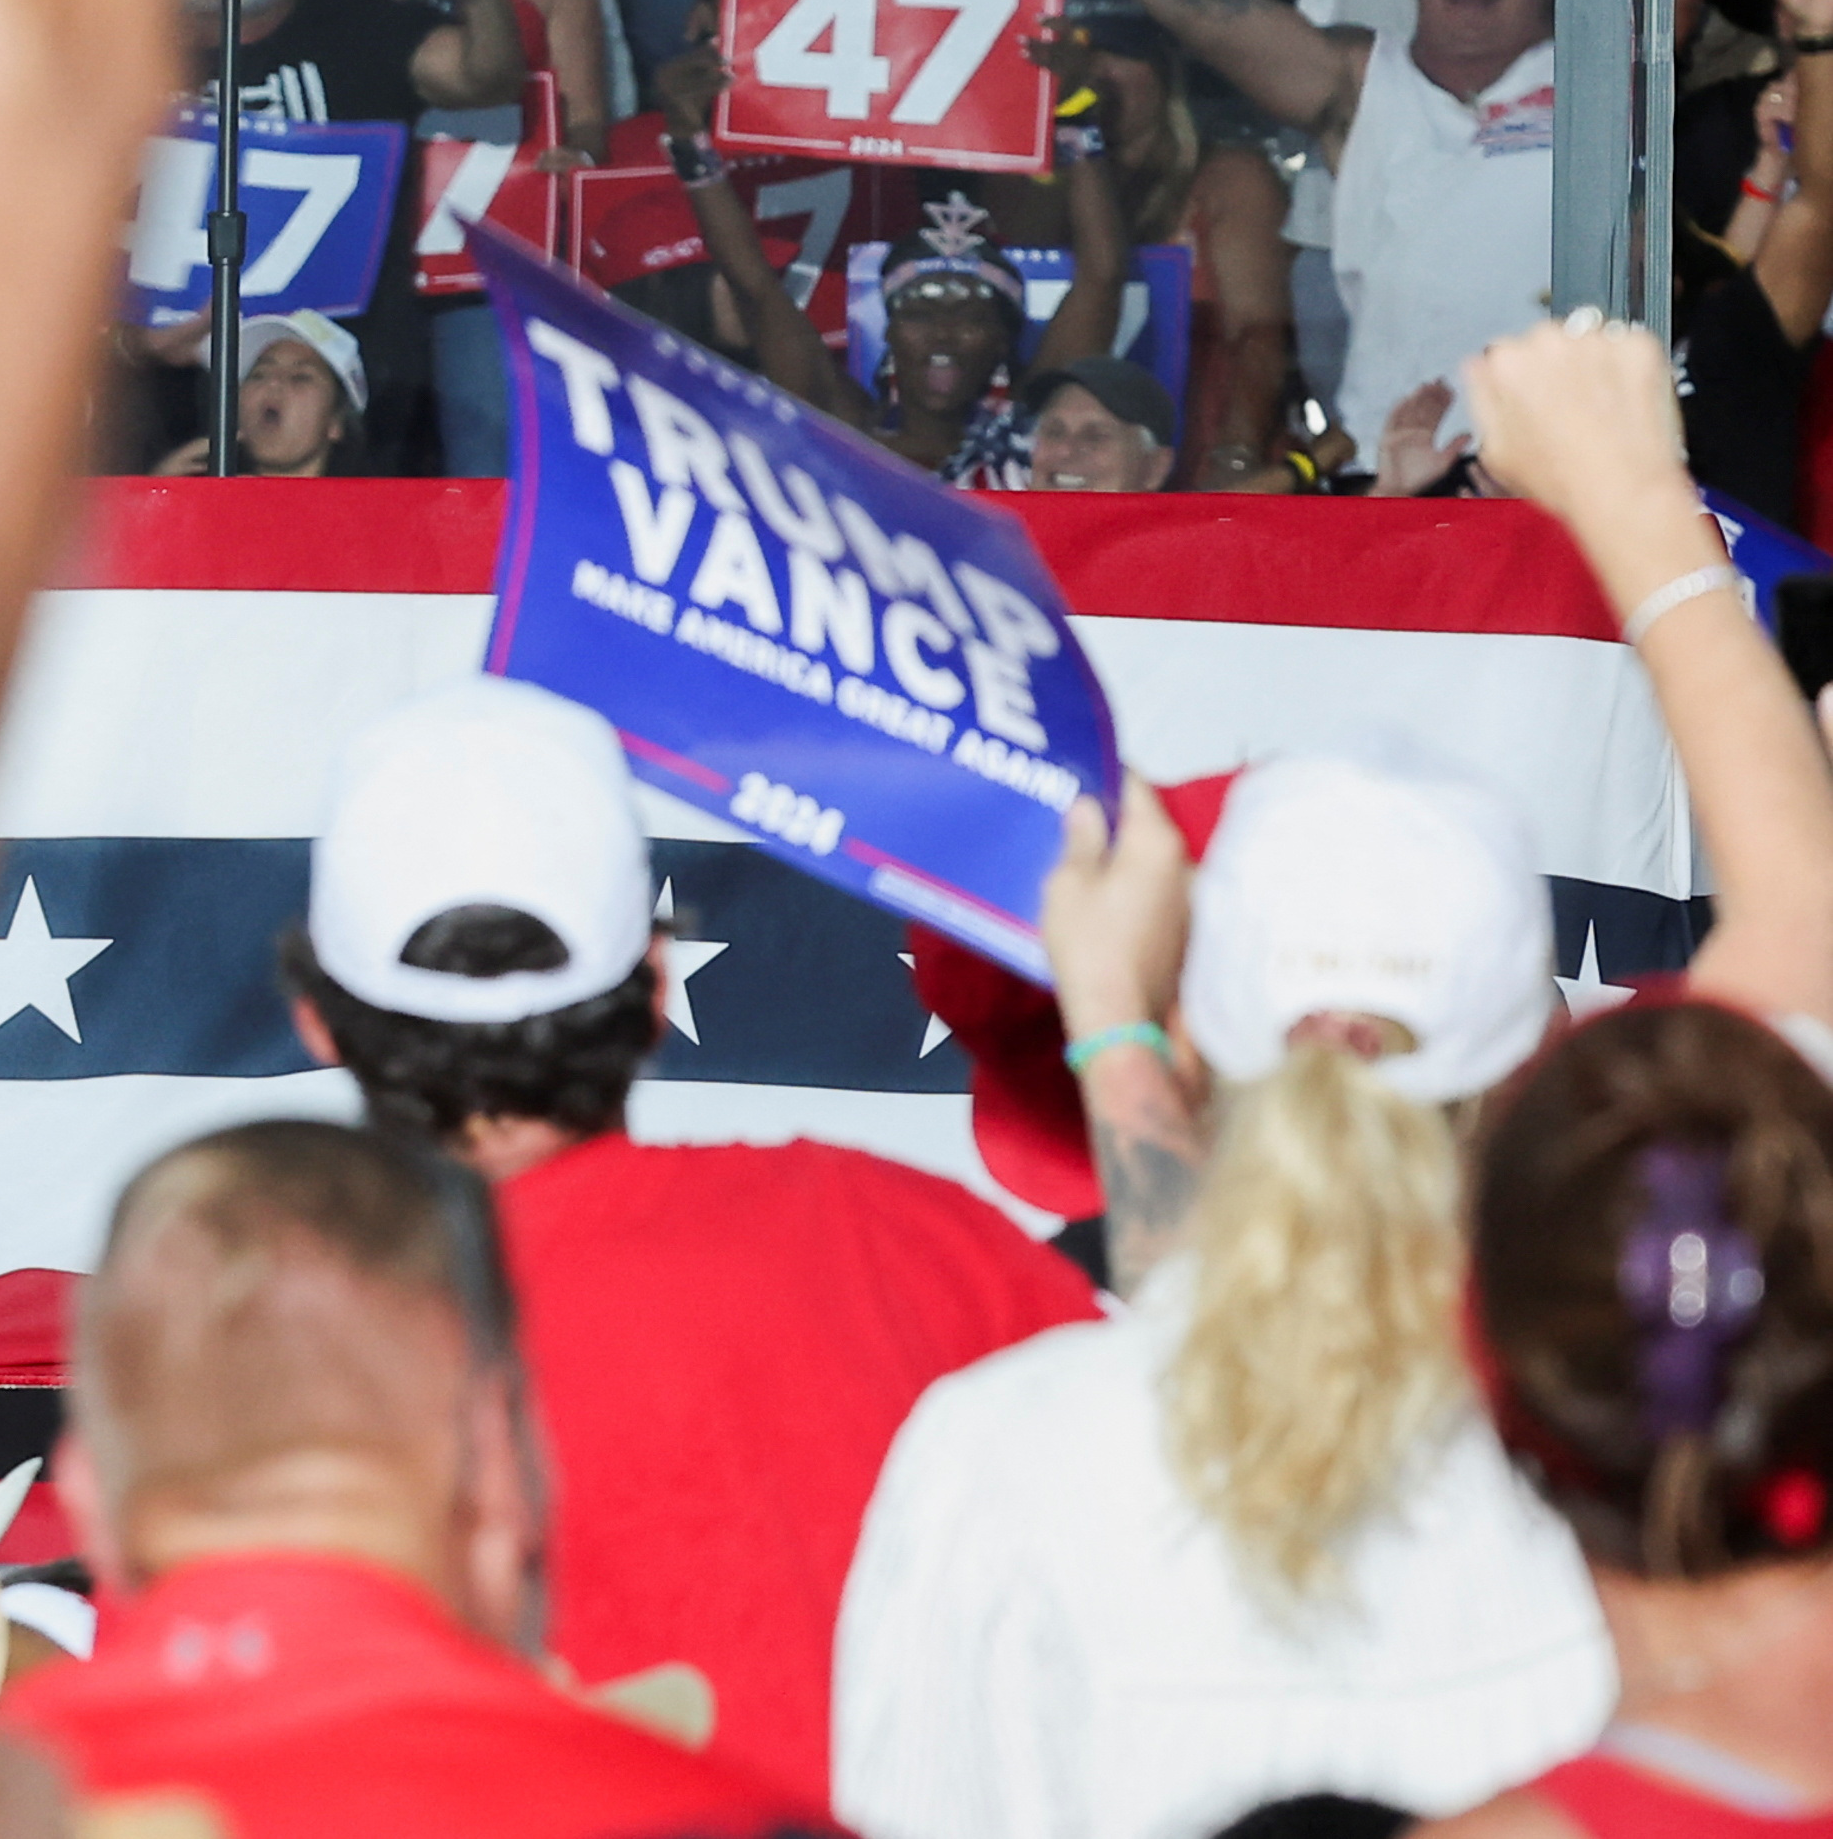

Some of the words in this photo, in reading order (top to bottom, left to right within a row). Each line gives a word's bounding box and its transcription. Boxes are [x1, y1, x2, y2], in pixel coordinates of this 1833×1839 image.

[849, 138, 904, 158] 2024
[757, 170, 854, 312] 7
[525, 316, 1062, 660] TRUMP
[571, 558, 674, 637] MAKE
[674, 604, 836, 706] AMERICA
[836, 676, 956, 755] GREAT
[610, 459, 1048, 754] VANCE
[728, 771, 847, 855] 2024
